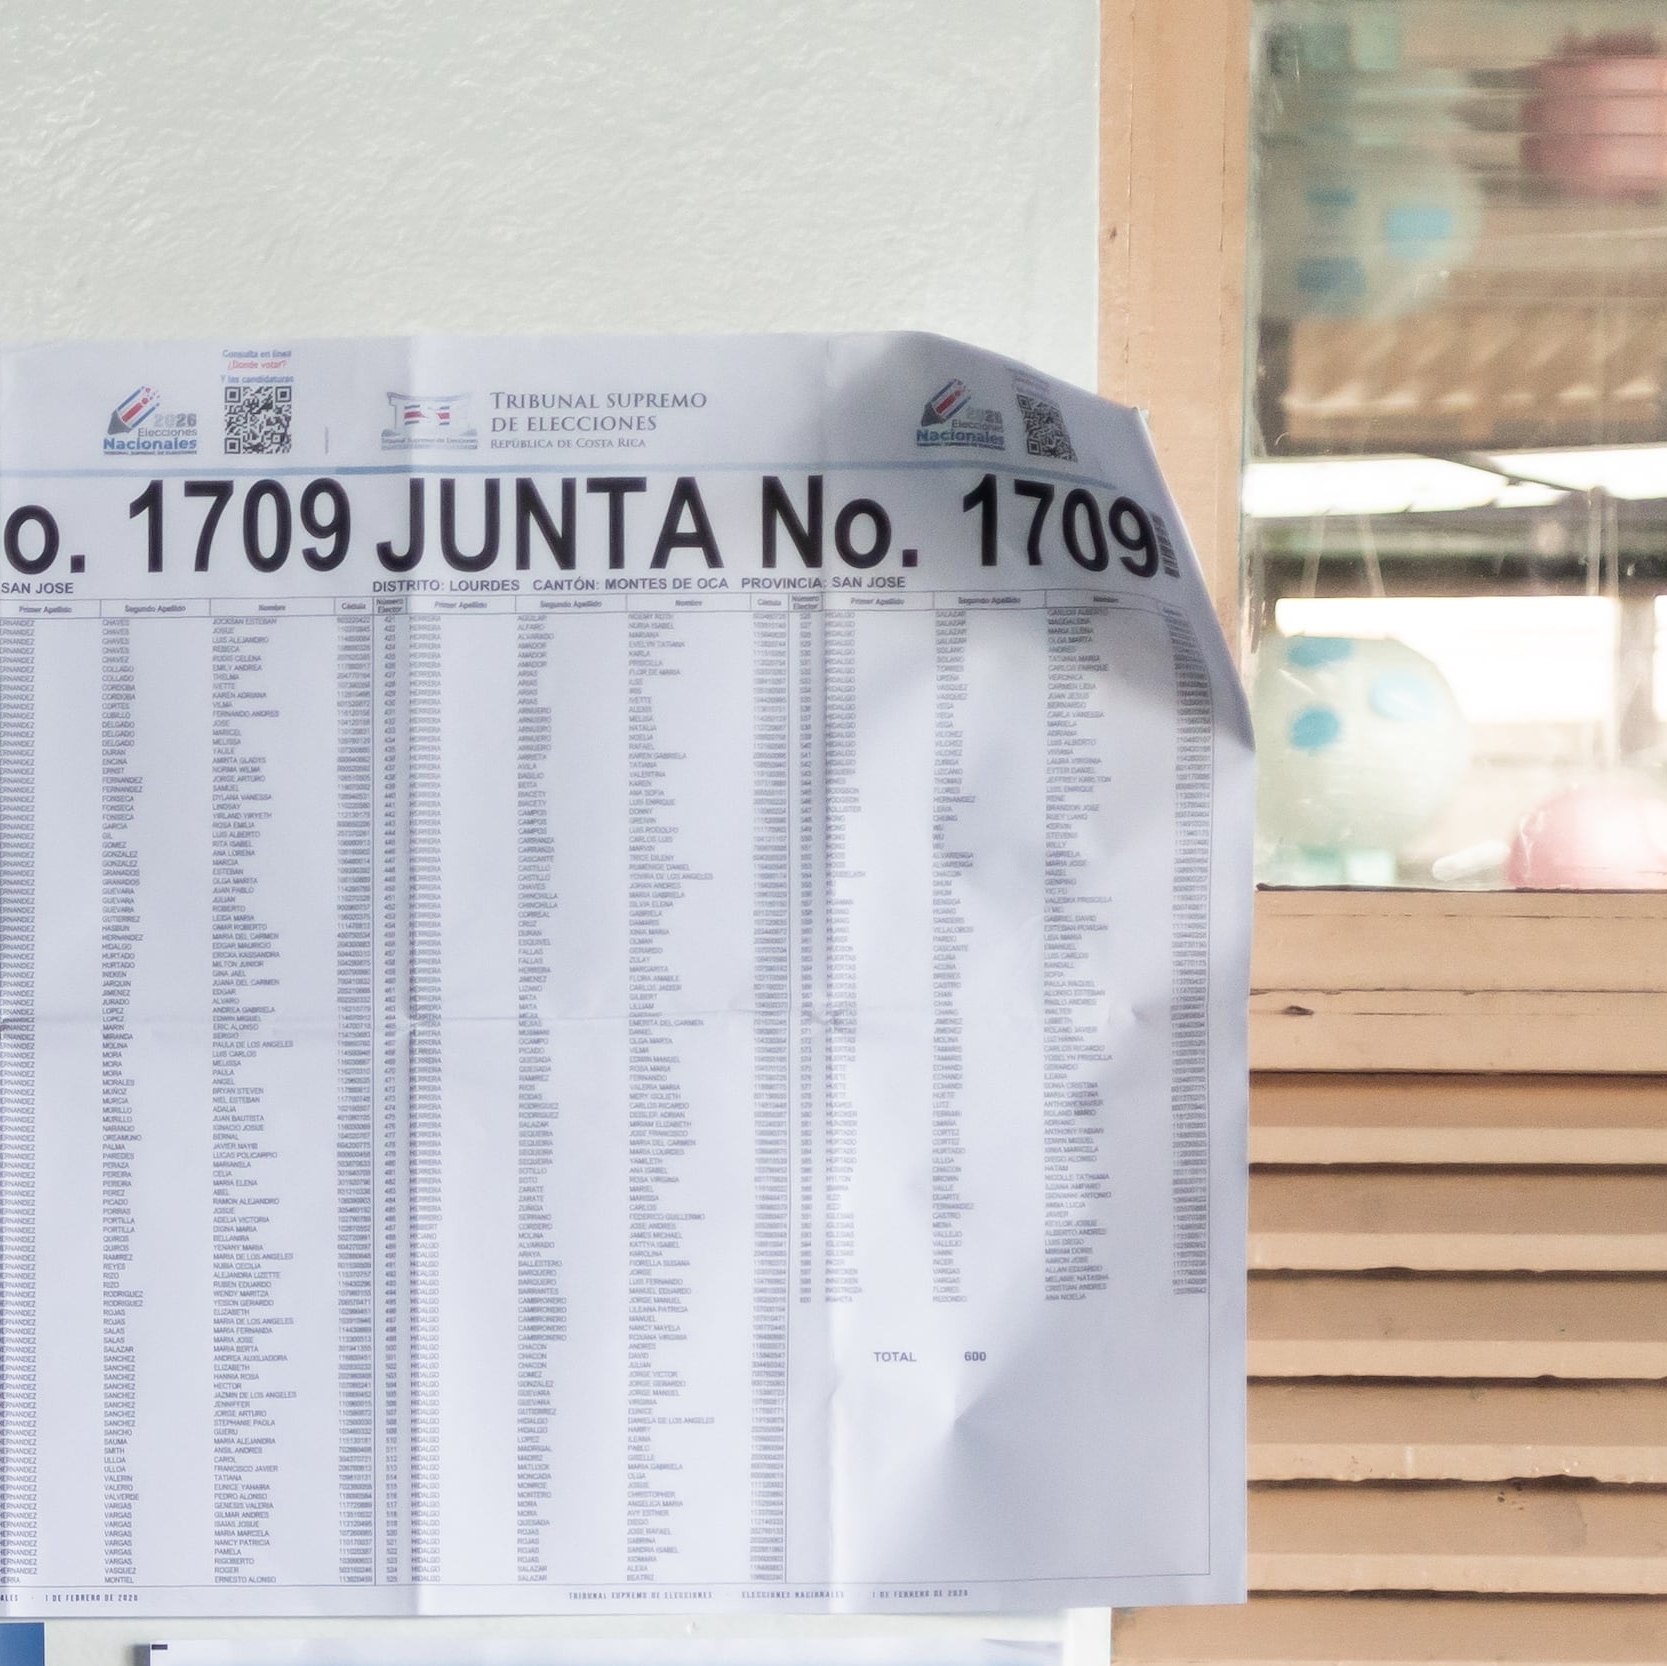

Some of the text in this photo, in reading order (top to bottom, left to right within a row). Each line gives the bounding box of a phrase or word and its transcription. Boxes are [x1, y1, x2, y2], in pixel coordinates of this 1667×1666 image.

[490, 392, 707, 409] TRIBUNAL SUPREMO
[492, 416, 656, 432] DE ELECCIONES
[129, 478, 351, 574] 1709
[376, 473, 1159, 577] JUNTA No. 1709
[873, 1352, 916, 1362] TOTAL
